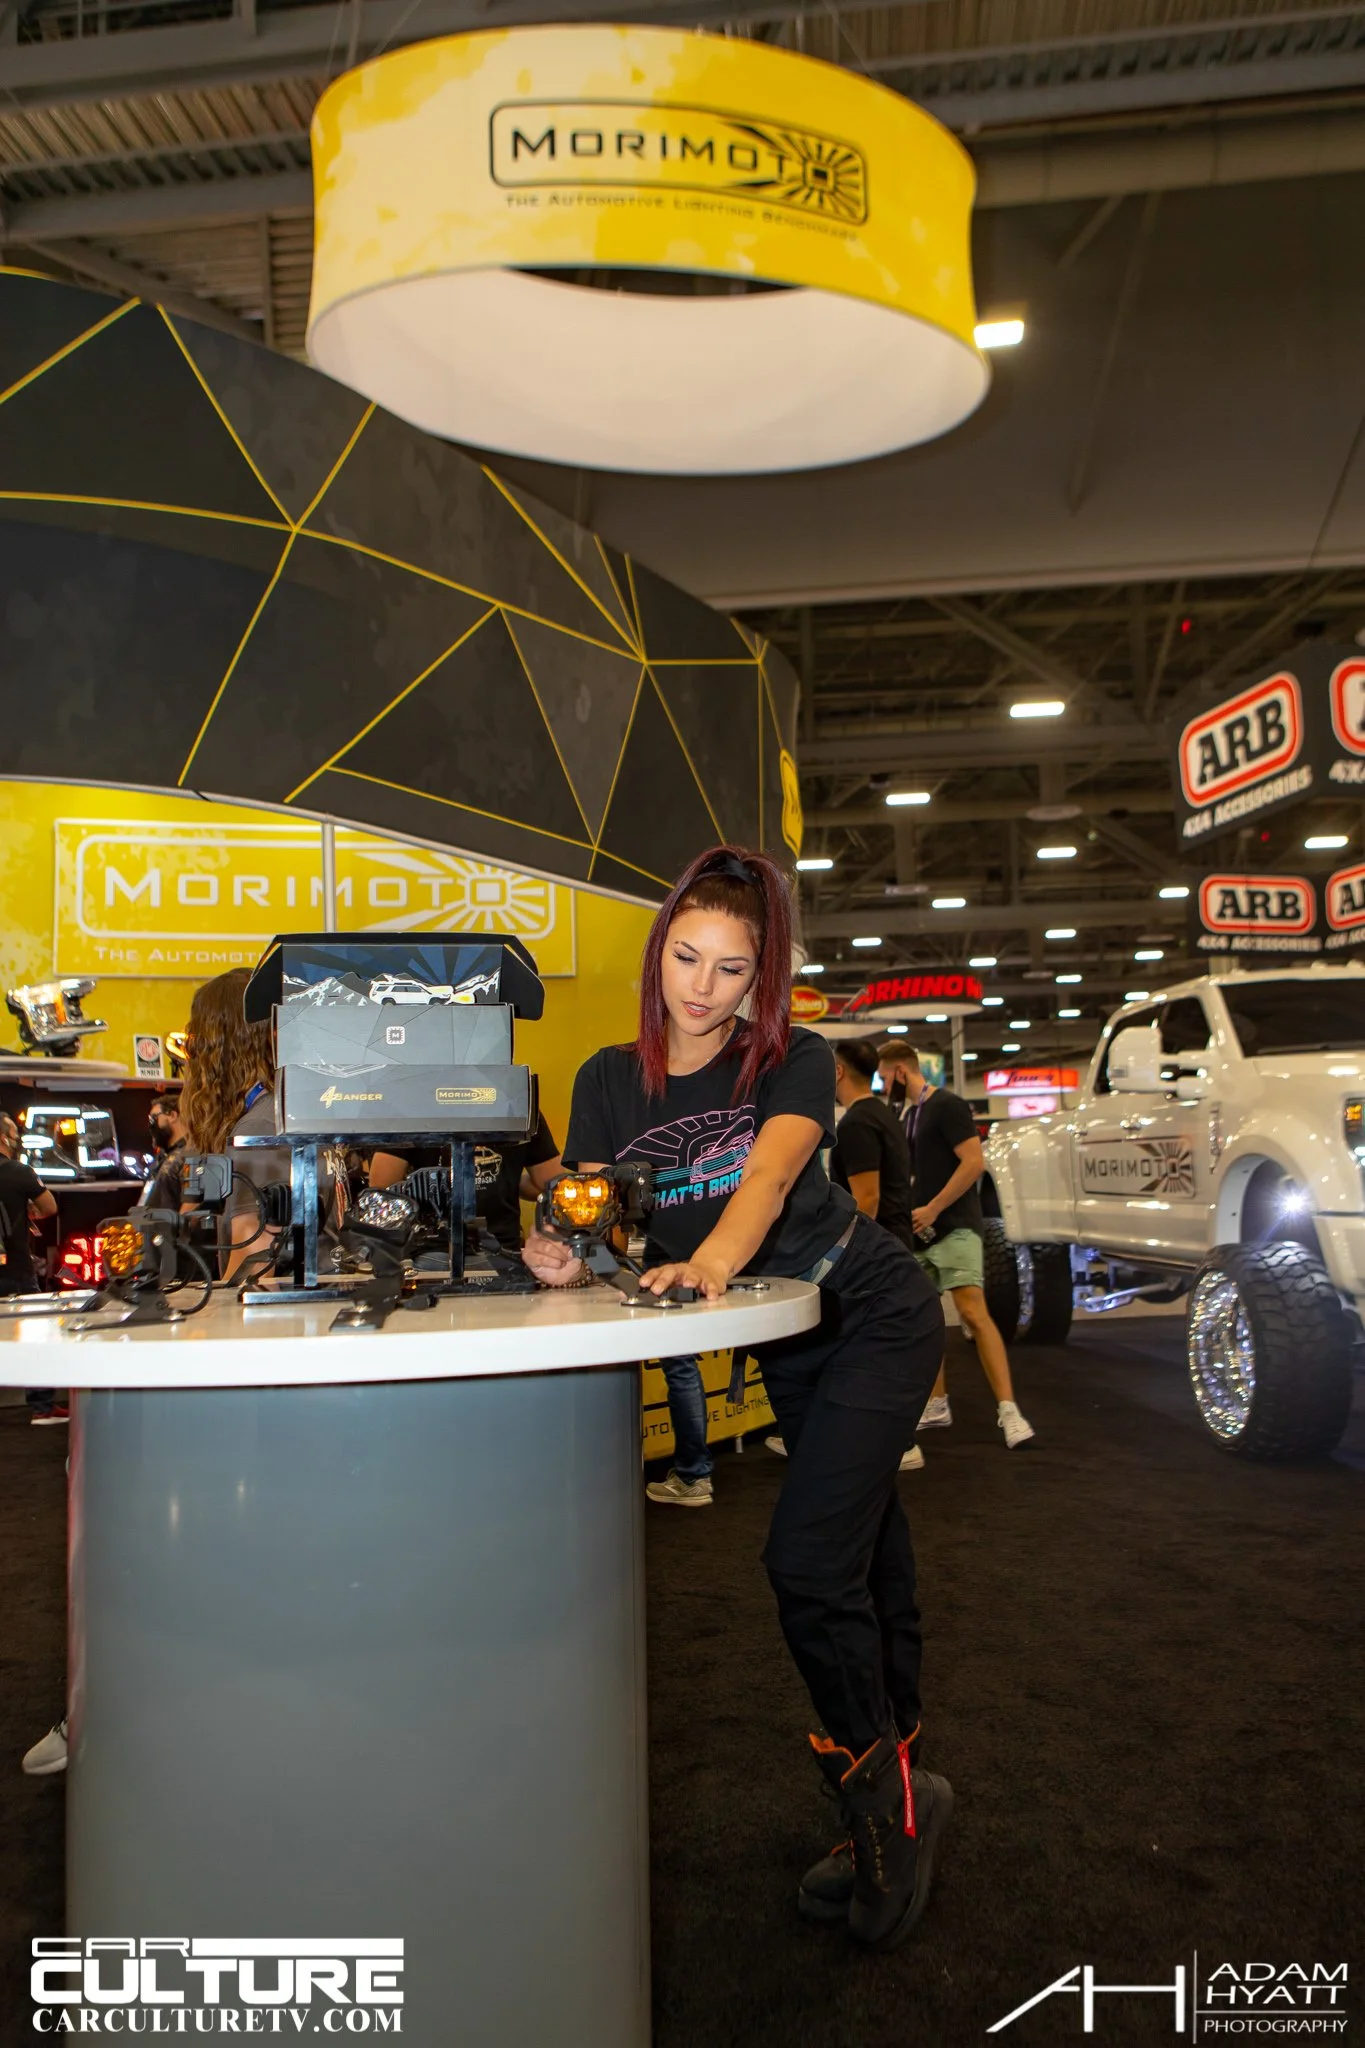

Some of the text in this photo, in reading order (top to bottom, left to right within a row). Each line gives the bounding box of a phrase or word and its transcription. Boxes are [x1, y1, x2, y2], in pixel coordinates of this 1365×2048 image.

[1197, 698, 1286, 785] ARB
[1216, 889, 1303, 921] ARB
[95, 946, 139, 962] THE
[652, 1182, 704, 1210] HAT'S
